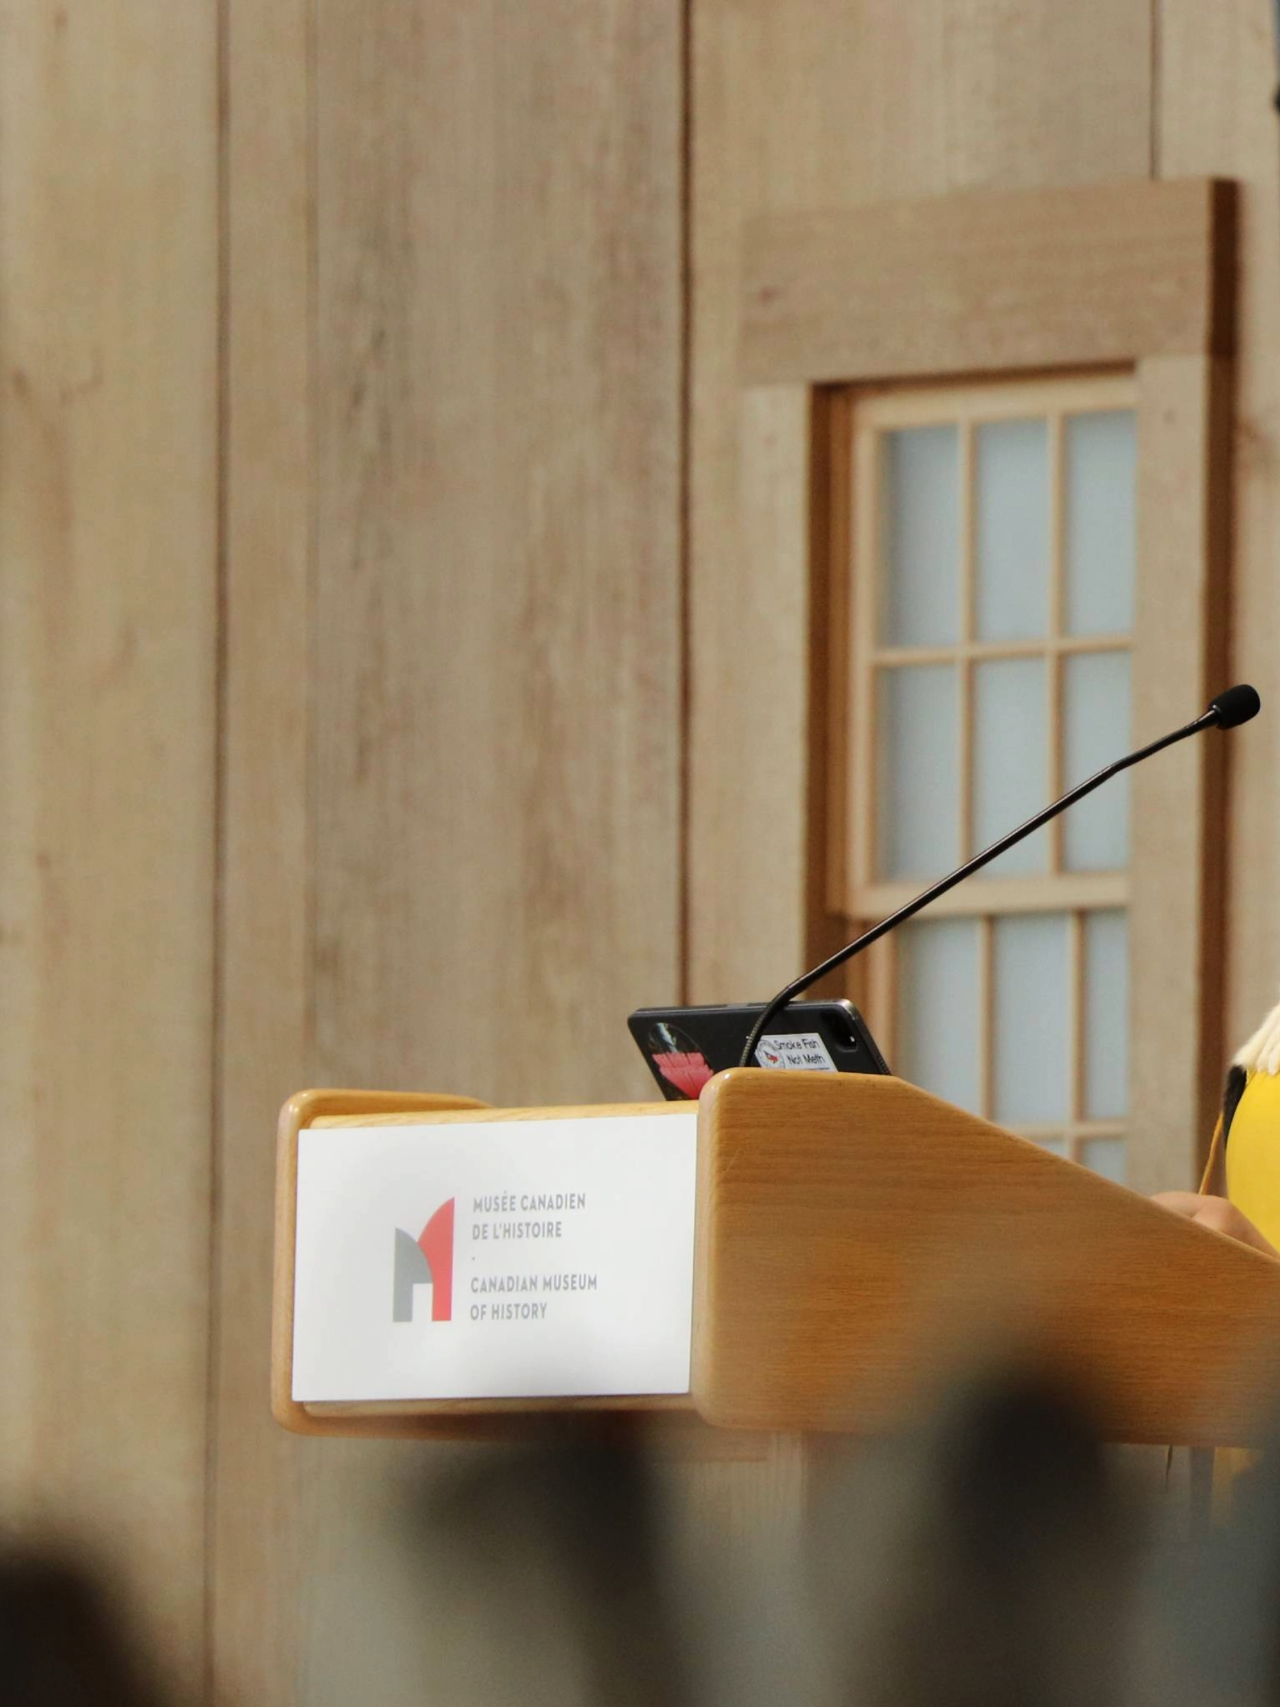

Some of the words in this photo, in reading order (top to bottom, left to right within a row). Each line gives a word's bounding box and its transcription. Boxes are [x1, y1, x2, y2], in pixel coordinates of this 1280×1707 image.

[773, 1039, 802, 1050] Smoke
[802, 1038, 820, 1049] Fish
[787, 1054, 802, 1065] Not
[803, 1053, 826, 1064] Meth
[473, 1191, 516, 1213] MUSÉE
[520, 1193, 586, 1211] CANADIEN
[472, 1224, 489, 1240] DE
[493, 1221, 562, 1239] L'HISTOIRE
[471, 1275, 538, 1293] CANADIAN
[542, 1274, 597, 1291] MUSEUM
[470, 1304, 487, 1320] OF
[491, 1302, 548, 1320] HISTORY
